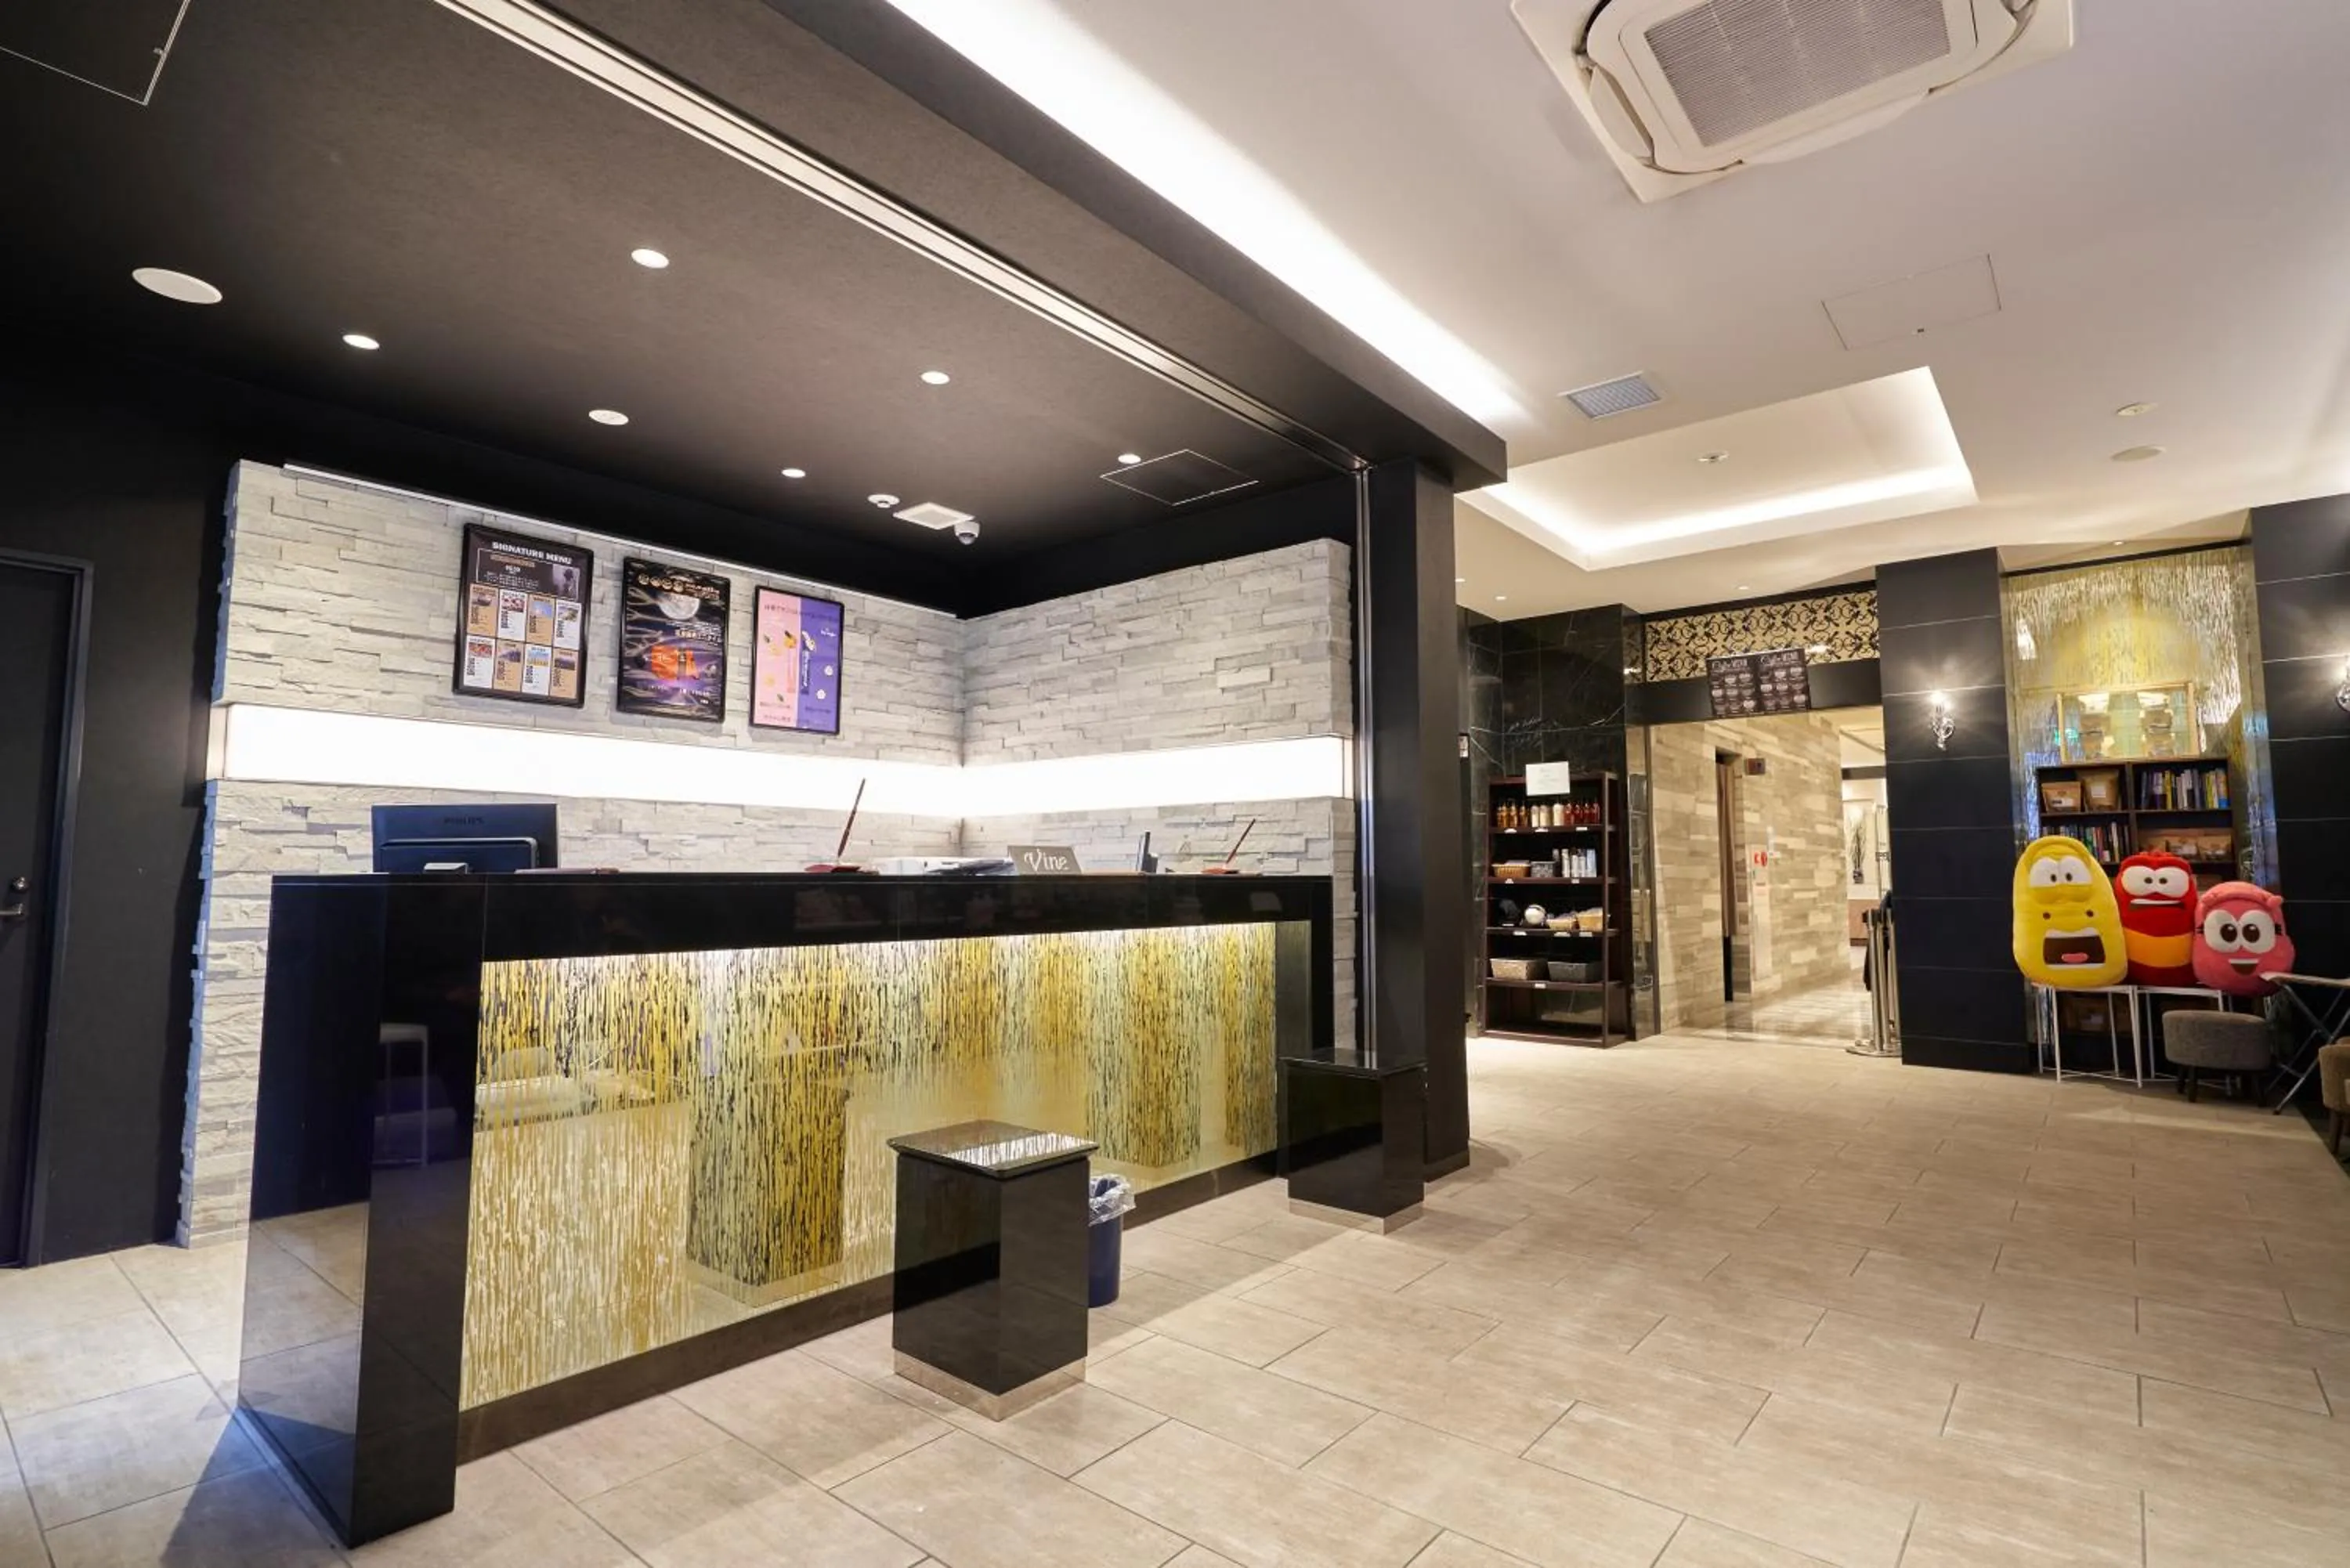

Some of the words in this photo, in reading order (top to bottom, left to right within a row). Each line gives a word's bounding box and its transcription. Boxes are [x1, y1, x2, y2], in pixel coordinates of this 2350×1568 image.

[491, 541, 544, 558] SIGNATURE
[546, 551, 573, 565] MENU
[1024, 848, 1069, 871] Vine
